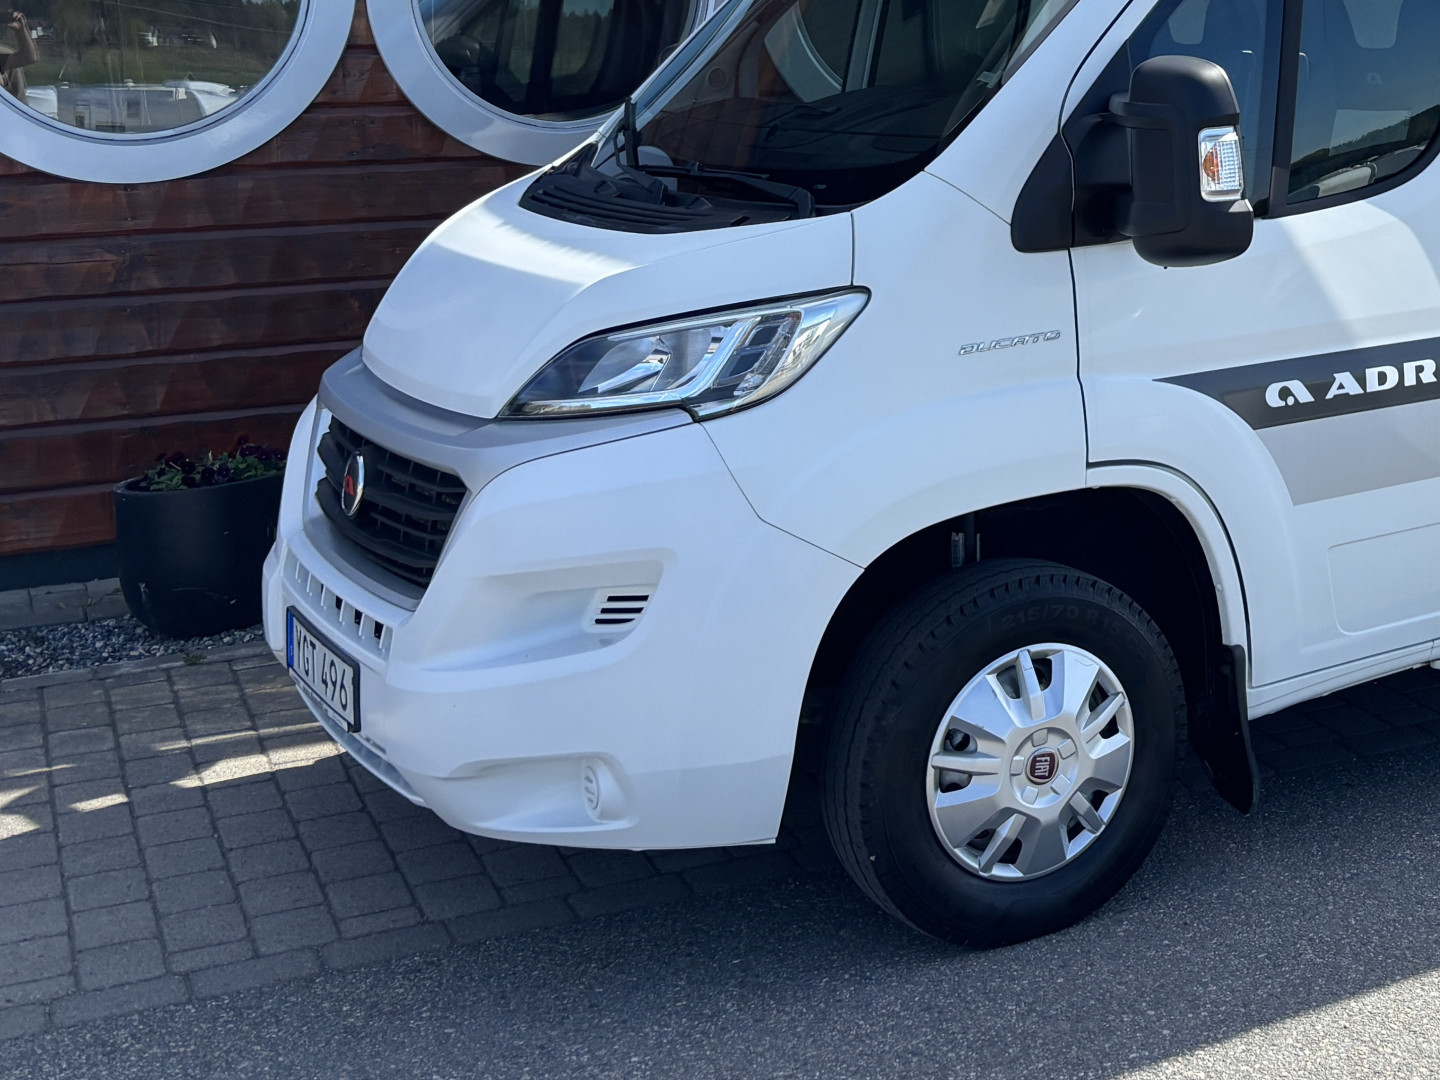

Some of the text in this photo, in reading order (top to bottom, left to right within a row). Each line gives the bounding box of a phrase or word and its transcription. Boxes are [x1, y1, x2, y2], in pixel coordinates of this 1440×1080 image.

[959, 330, 1061, 355] DUCATO
[296, 625, 348, 712] YGT 496
[1034, 756, 1051, 777] FIAT
